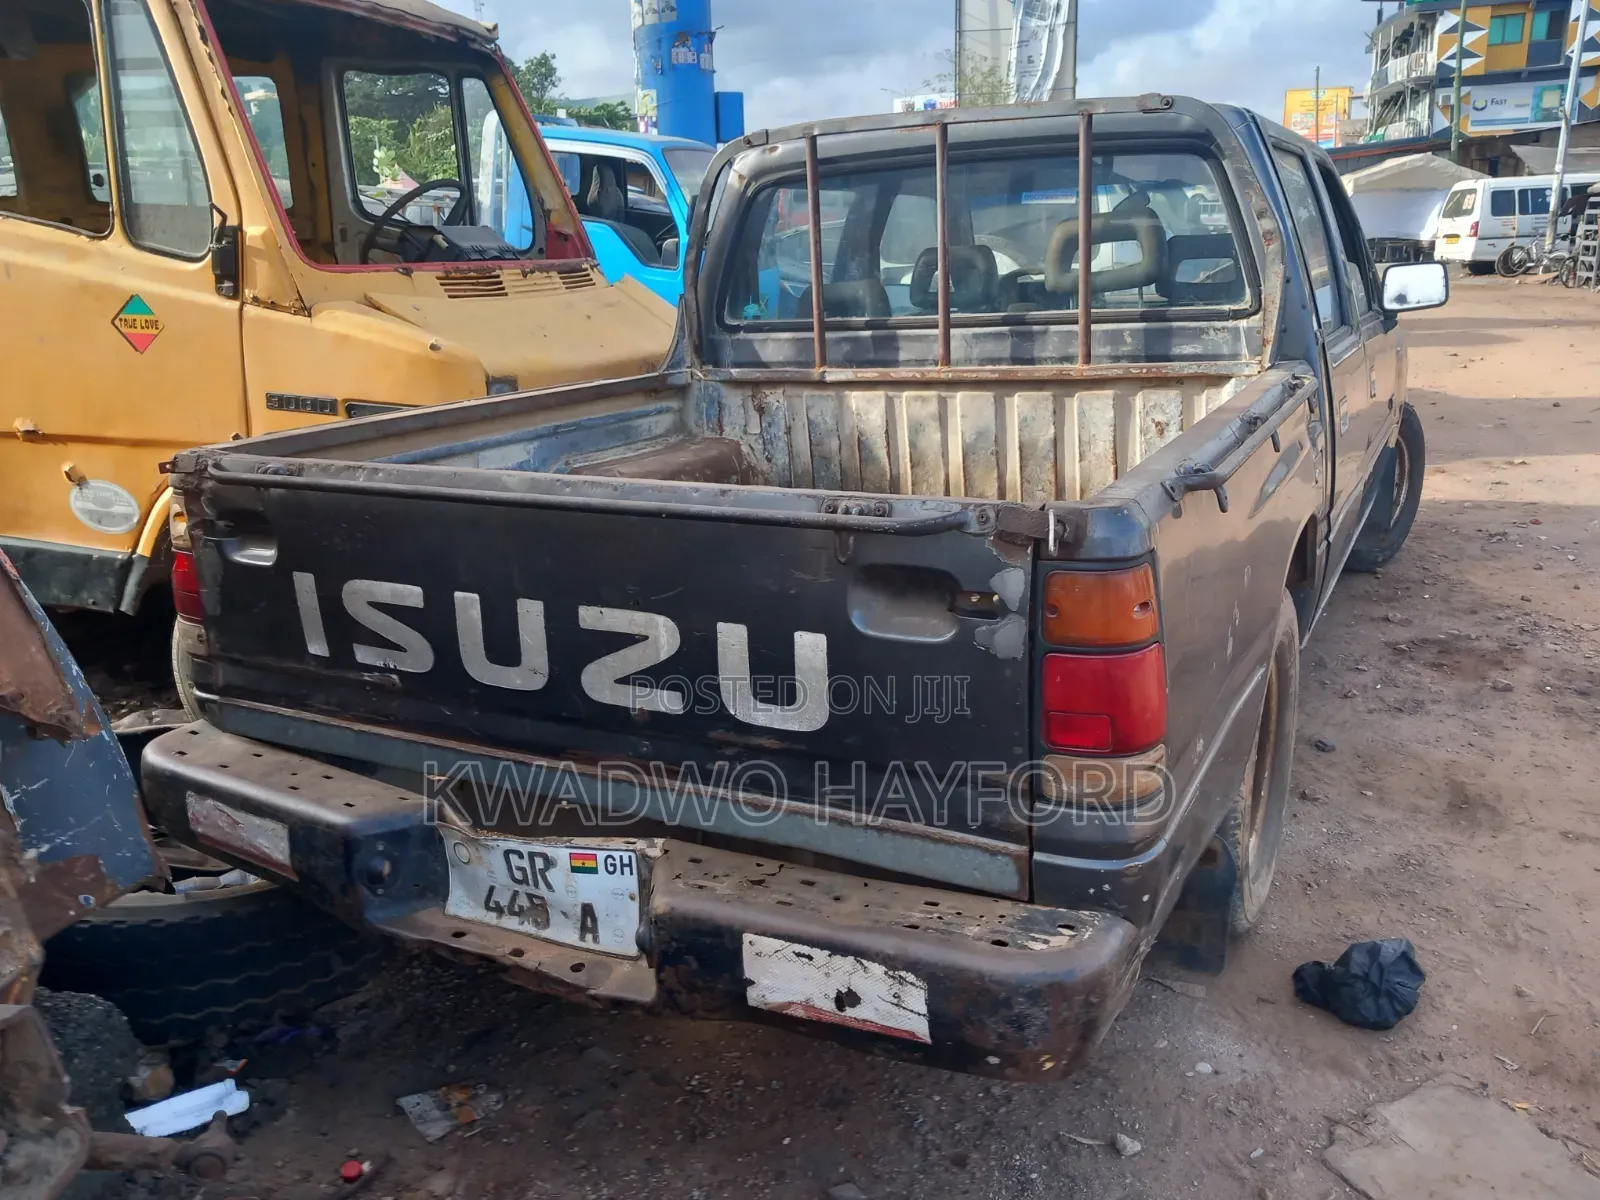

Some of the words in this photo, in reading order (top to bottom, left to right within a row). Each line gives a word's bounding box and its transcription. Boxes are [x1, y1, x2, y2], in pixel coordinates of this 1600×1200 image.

[118, 317, 138, 330] TRUE
[139, 318, 160, 331] LOVE
[292, 571, 830, 732] ISUZU
[503, 849, 555, 893] GR
[604, 854, 634, 876] GH
[579, 902, 600, 944] A
